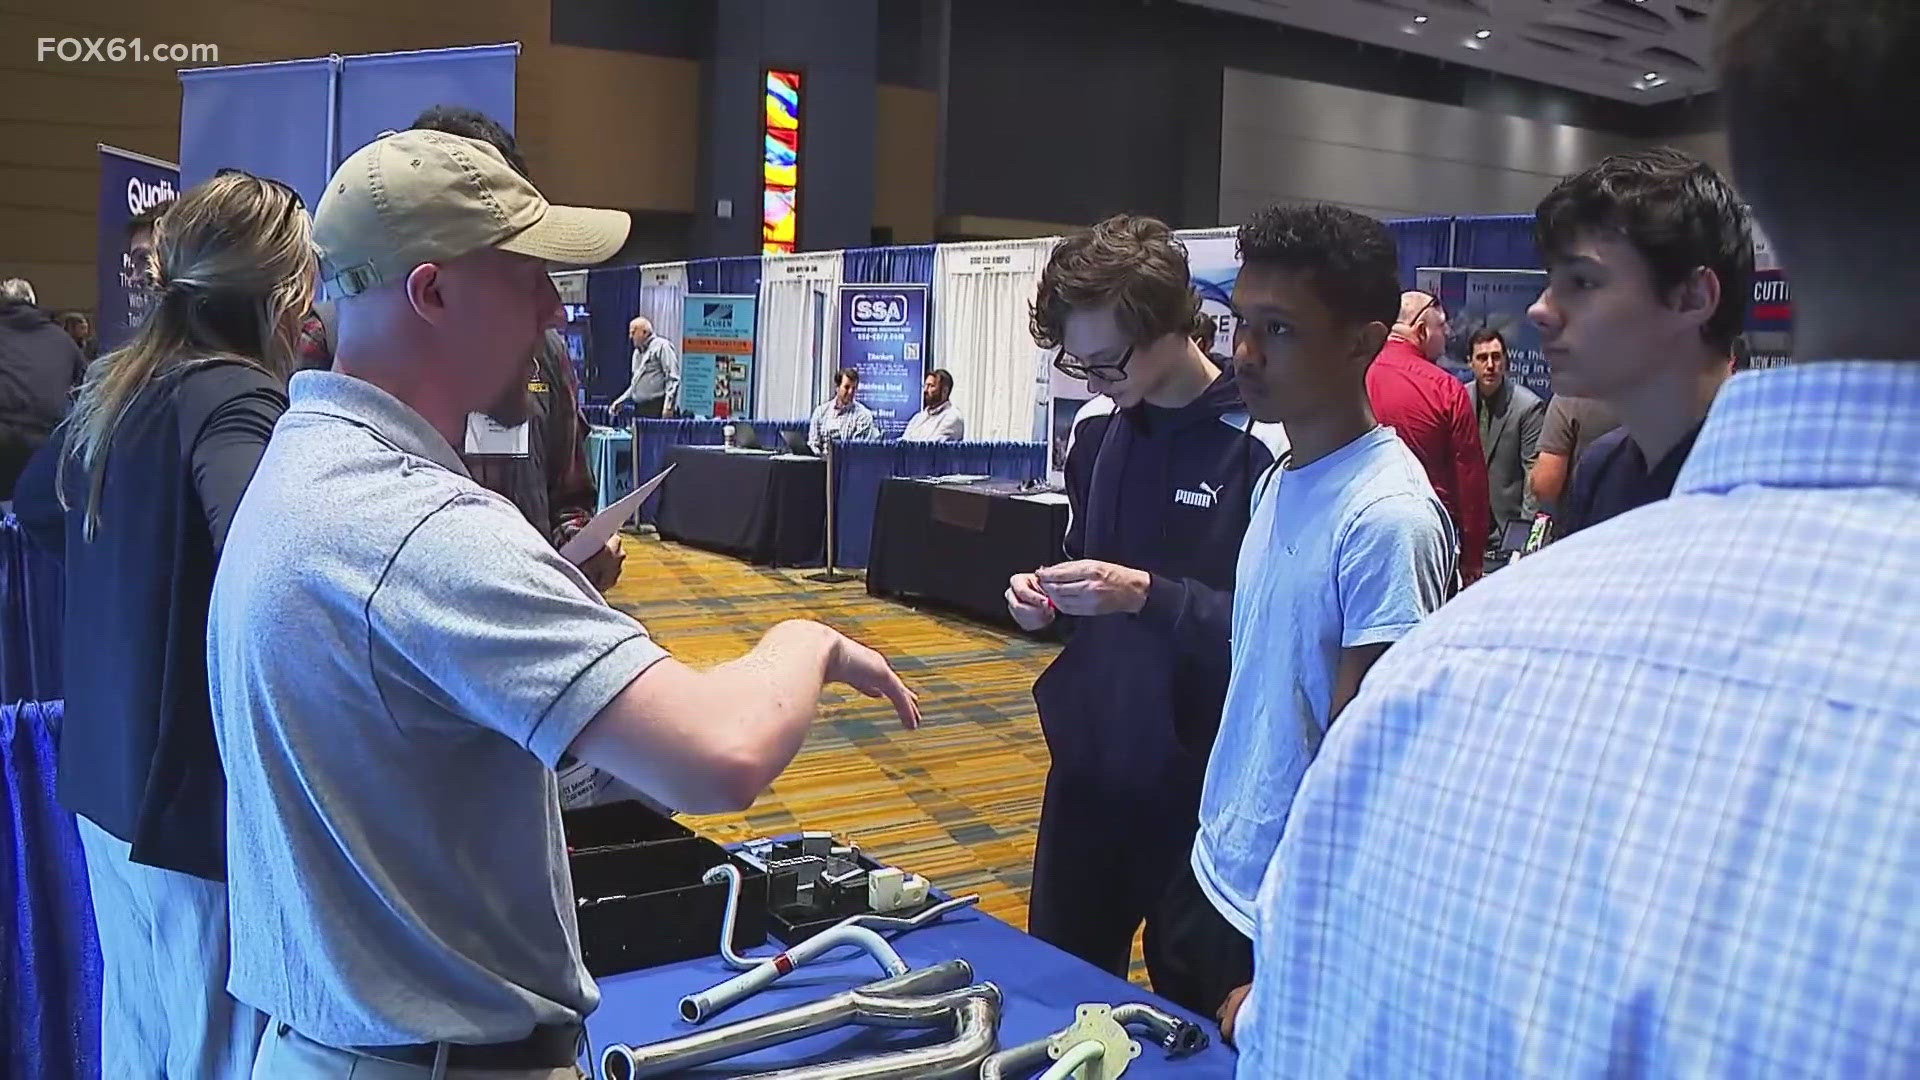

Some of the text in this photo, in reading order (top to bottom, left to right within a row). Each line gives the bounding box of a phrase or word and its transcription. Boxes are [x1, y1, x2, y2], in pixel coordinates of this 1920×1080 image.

[1753, 280, 1790, 302] CUTTI
[856, 300, 901, 323] SSA
[1507, 347, 1545, 359] We thi
[1509, 361, 1529, 375] big
[1749, 355, 1769, 370] NOW
[1174, 489, 1212, 508] PUMA
